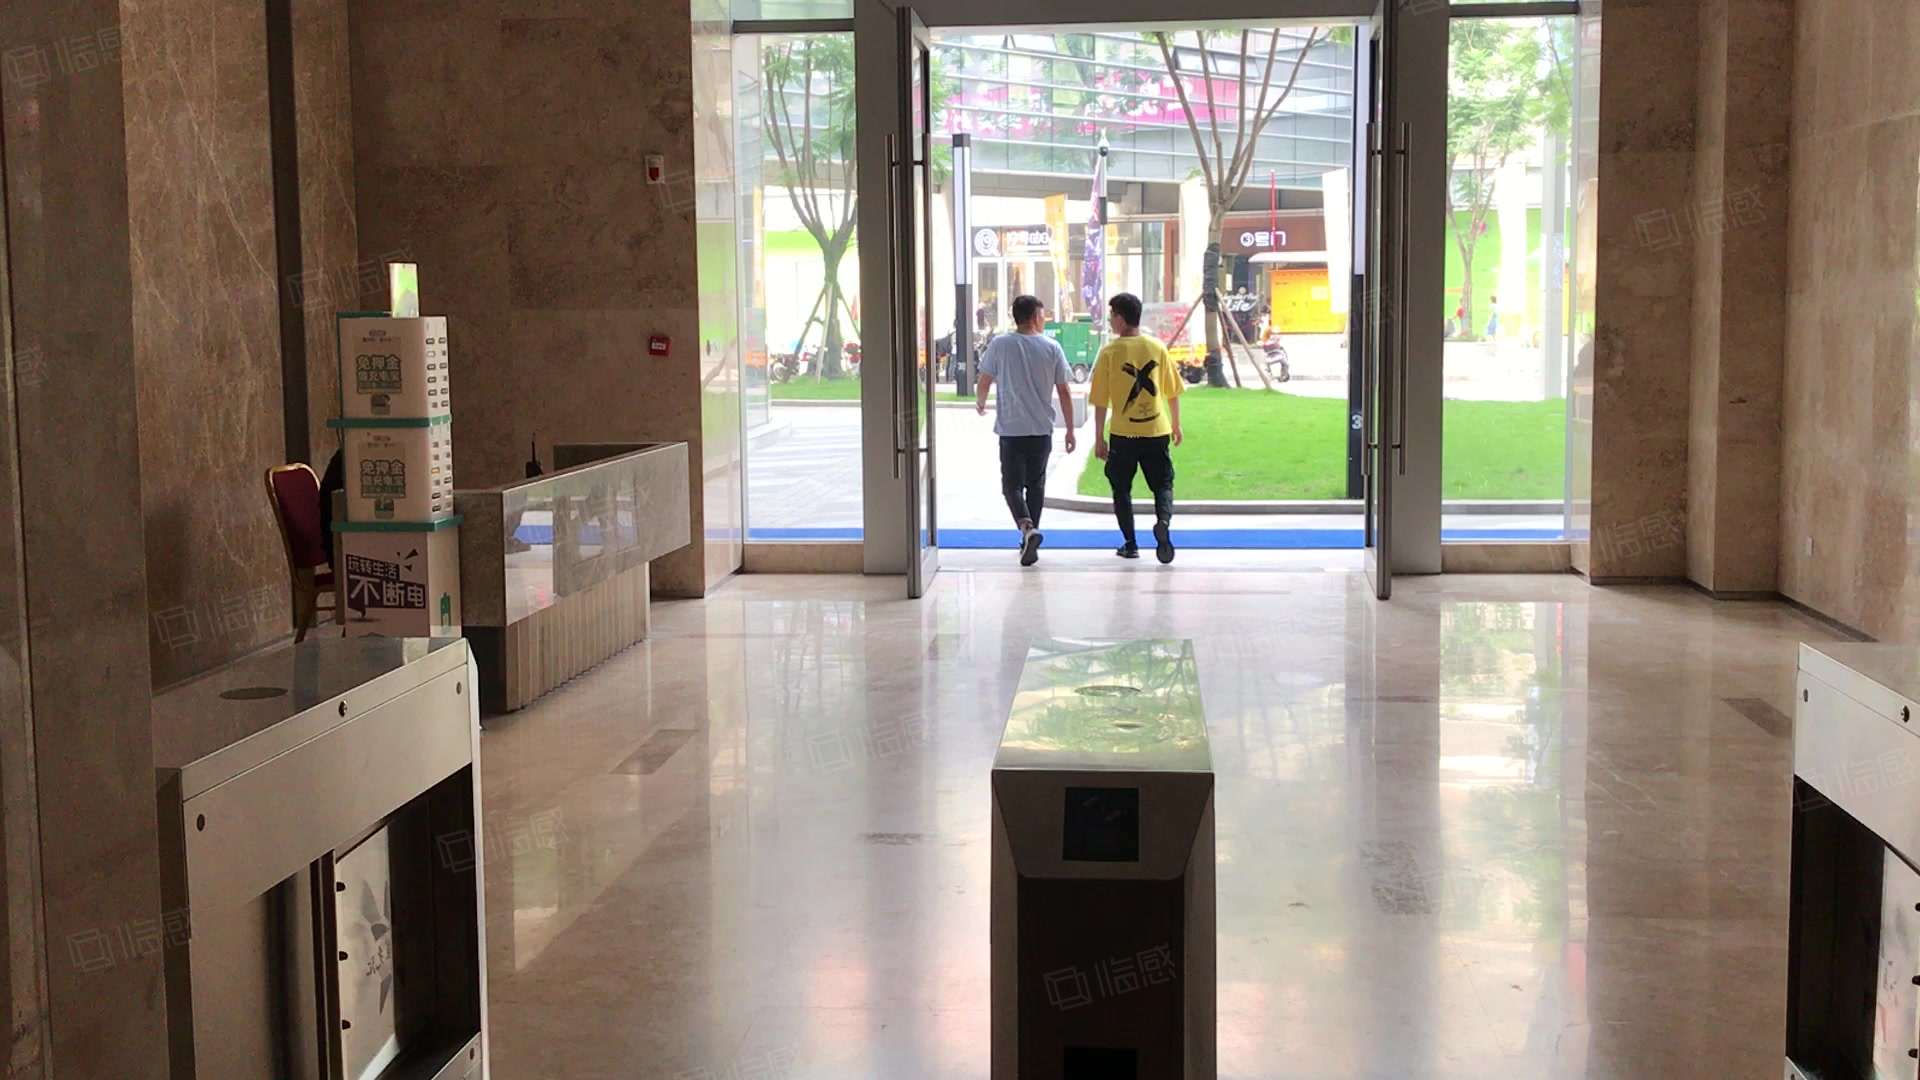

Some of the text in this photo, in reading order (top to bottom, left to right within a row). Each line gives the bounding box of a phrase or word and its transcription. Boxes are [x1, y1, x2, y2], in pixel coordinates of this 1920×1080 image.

[358, 354, 401, 371] 免押金
[361, 460, 405, 475] 免押金
[348, 556, 398, 579] 玩转生活
[348, 573, 425, 608] 不断电
